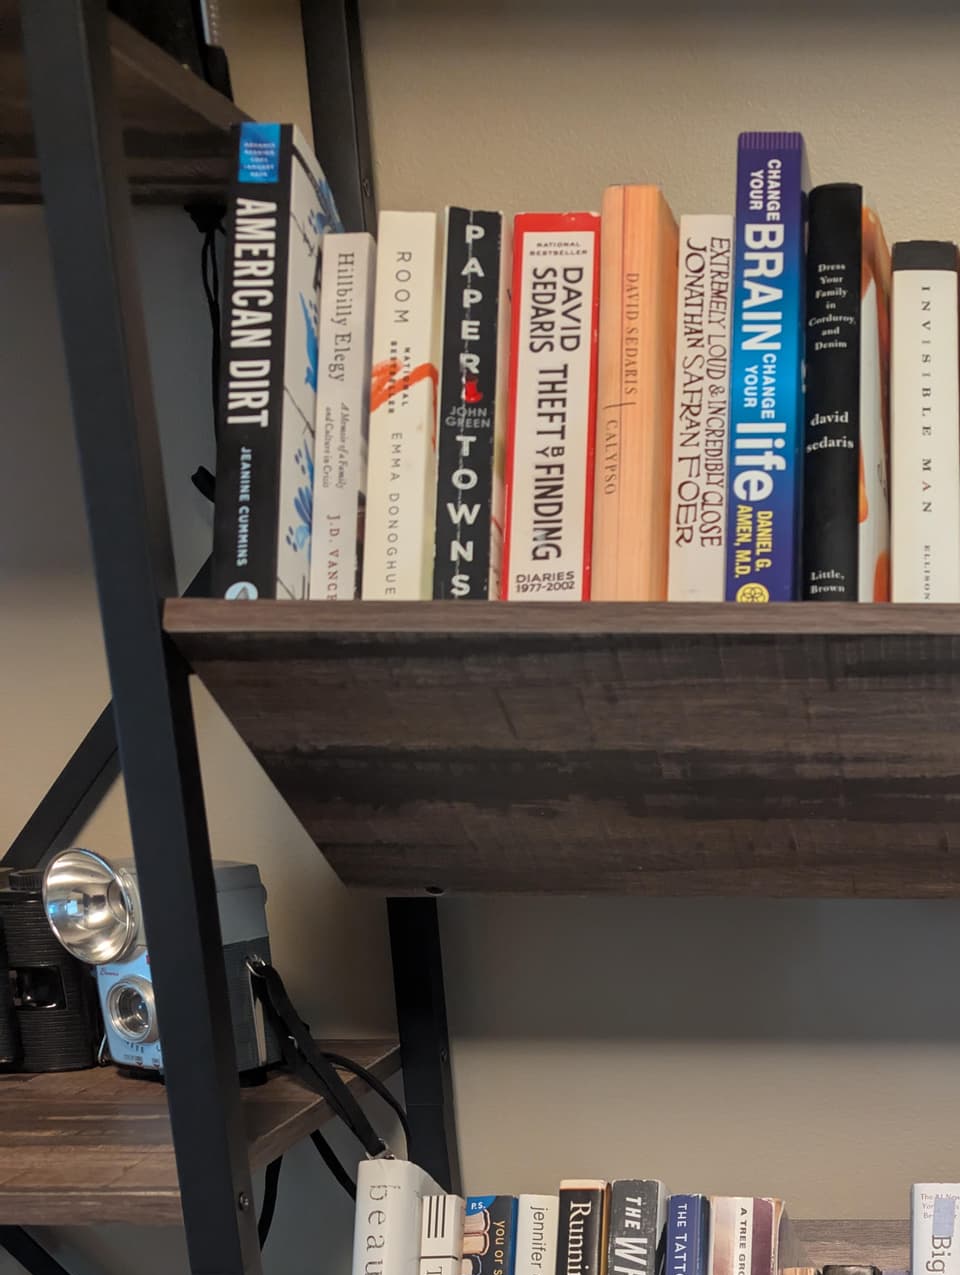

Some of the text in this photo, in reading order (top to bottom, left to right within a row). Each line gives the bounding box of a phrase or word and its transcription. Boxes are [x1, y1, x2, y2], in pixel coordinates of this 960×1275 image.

[749, 169, 765, 211] YOUR
[767, 159, 782, 221] CHANGE
[230, 198, 277, 348] AMERICAN
[394, 252, 411, 325] ROOM
[528, 267, 557, 354] SEDARIS
[560, 267, 584, 353] DAVID
[741, 223, 784, 353] BRAIN
[328, 252, 354, 382] Hillbilly Elegy
[623, 272, 640, 396] DAVID SEDARIS
[815, 341, 848, 351] Denim
[227, 359, 271, 428] DIRT
[743, 365, 758, 408] YOUR
[761, 352, 777, 419] CHANGE
[810, 411, 849, 426] david
[921, 286, 932, 512] INVISIBLE MAN
[531, 363, 569, 562] THEFT FINDING
[604, 419, 618, 496] CALYPSO
[734, 422, 786, 502] life
[806, 436, 854, 453] sedaris
[236, 446, 253, 567] JEANINE CUMMINS
[385, 431, 403, 594] EMMA DONOGHUE
[530, 1207, 549, 1268] jennifer
[625, 1197, 642, 1230] THE
